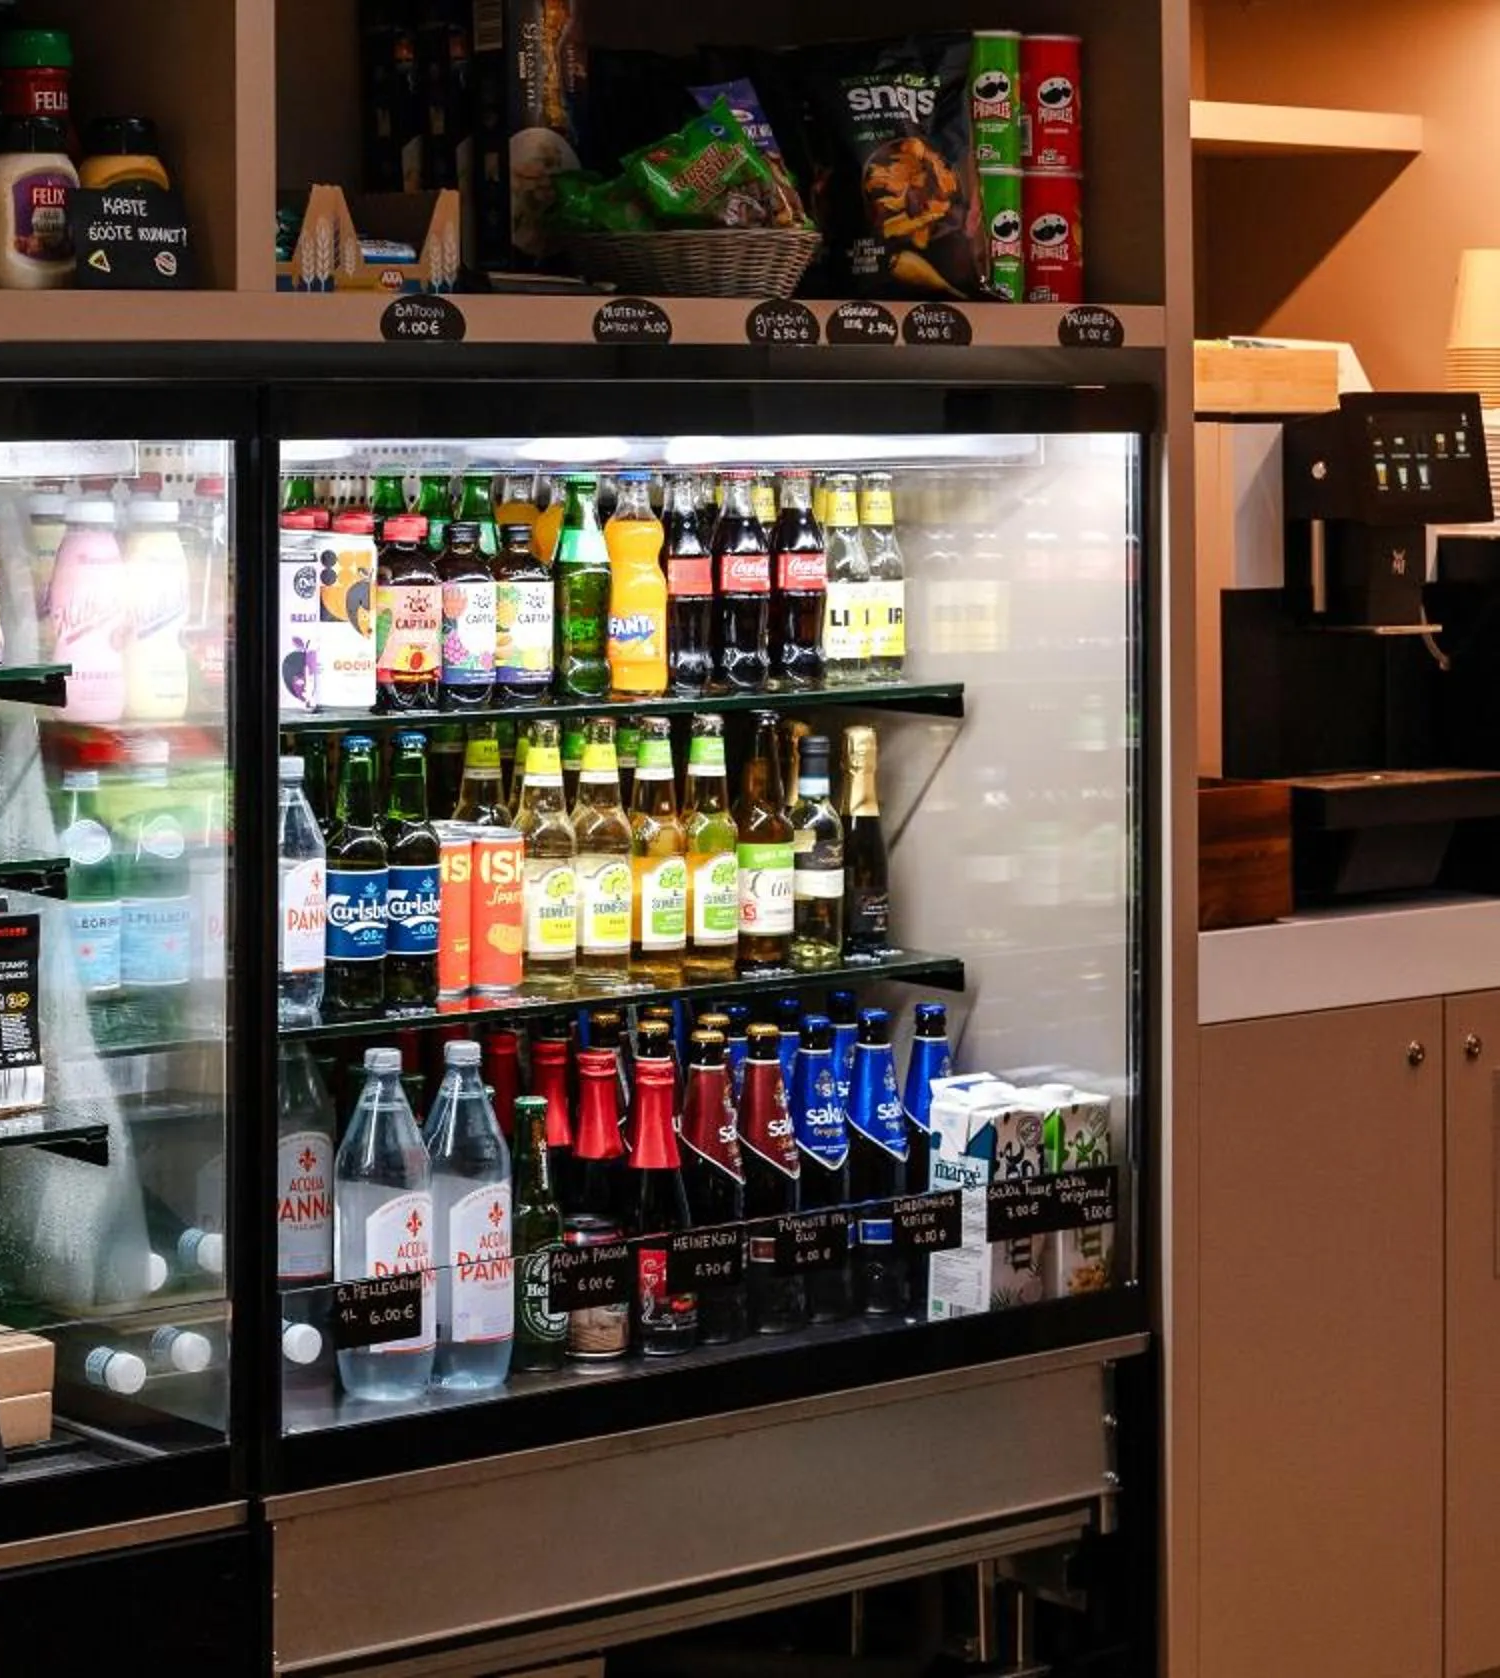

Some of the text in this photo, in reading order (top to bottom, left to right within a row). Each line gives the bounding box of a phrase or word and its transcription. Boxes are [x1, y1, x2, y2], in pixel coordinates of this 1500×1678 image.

[31, 187, 65, 205] FELIX
[288, 905, 326, 931] PANN
[673, 1231, 739, 1252] HEINEKEN
